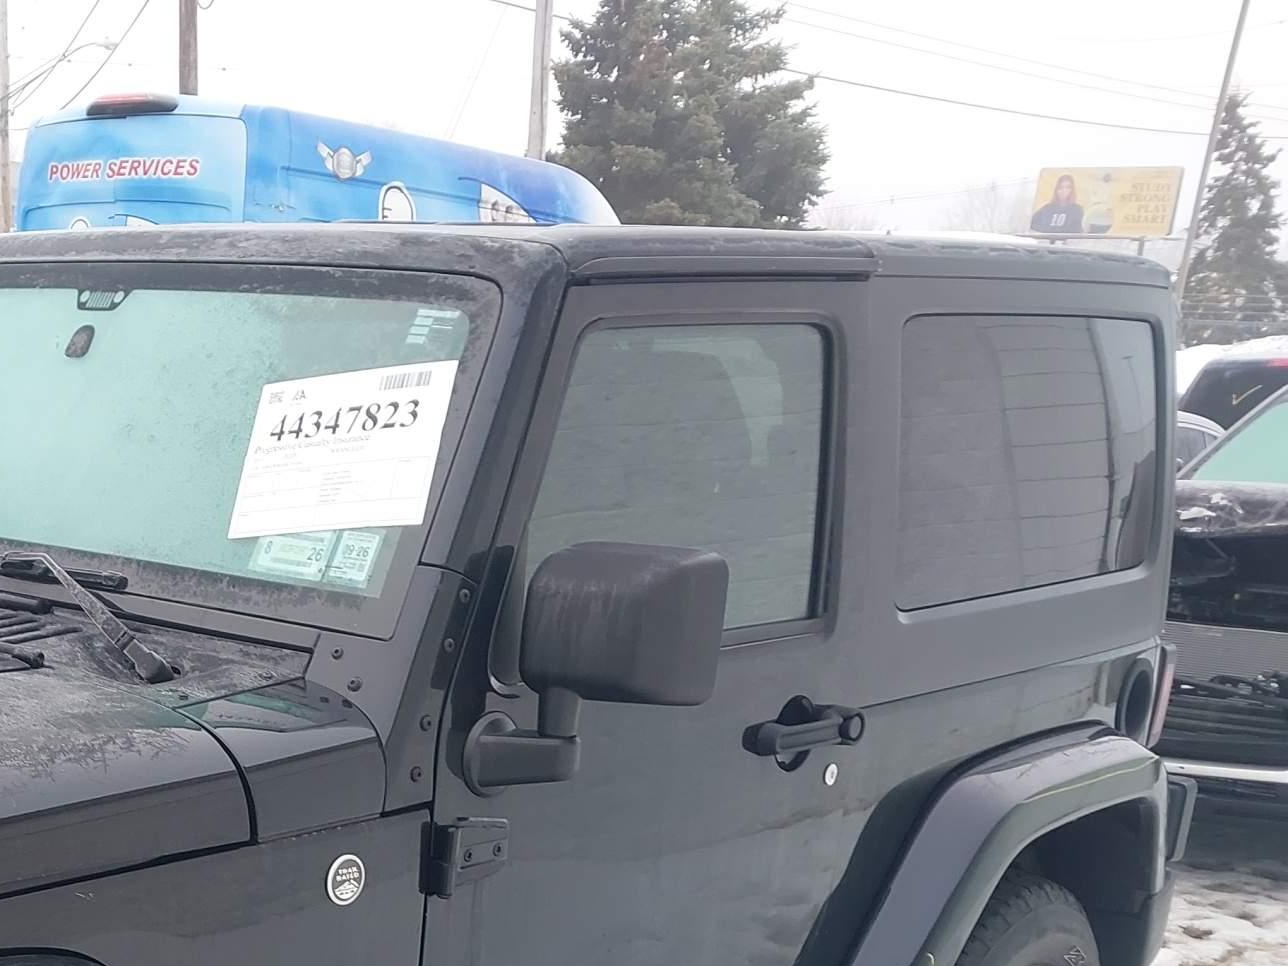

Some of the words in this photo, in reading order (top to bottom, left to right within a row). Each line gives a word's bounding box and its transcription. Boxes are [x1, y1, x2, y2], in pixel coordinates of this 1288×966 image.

[48, 162, 102, 181] POWER
[106, 158, 200, 179] SERVICES
[1049, 213, 1067, 226] 10
[270, 399, 420, 441] 44347823
